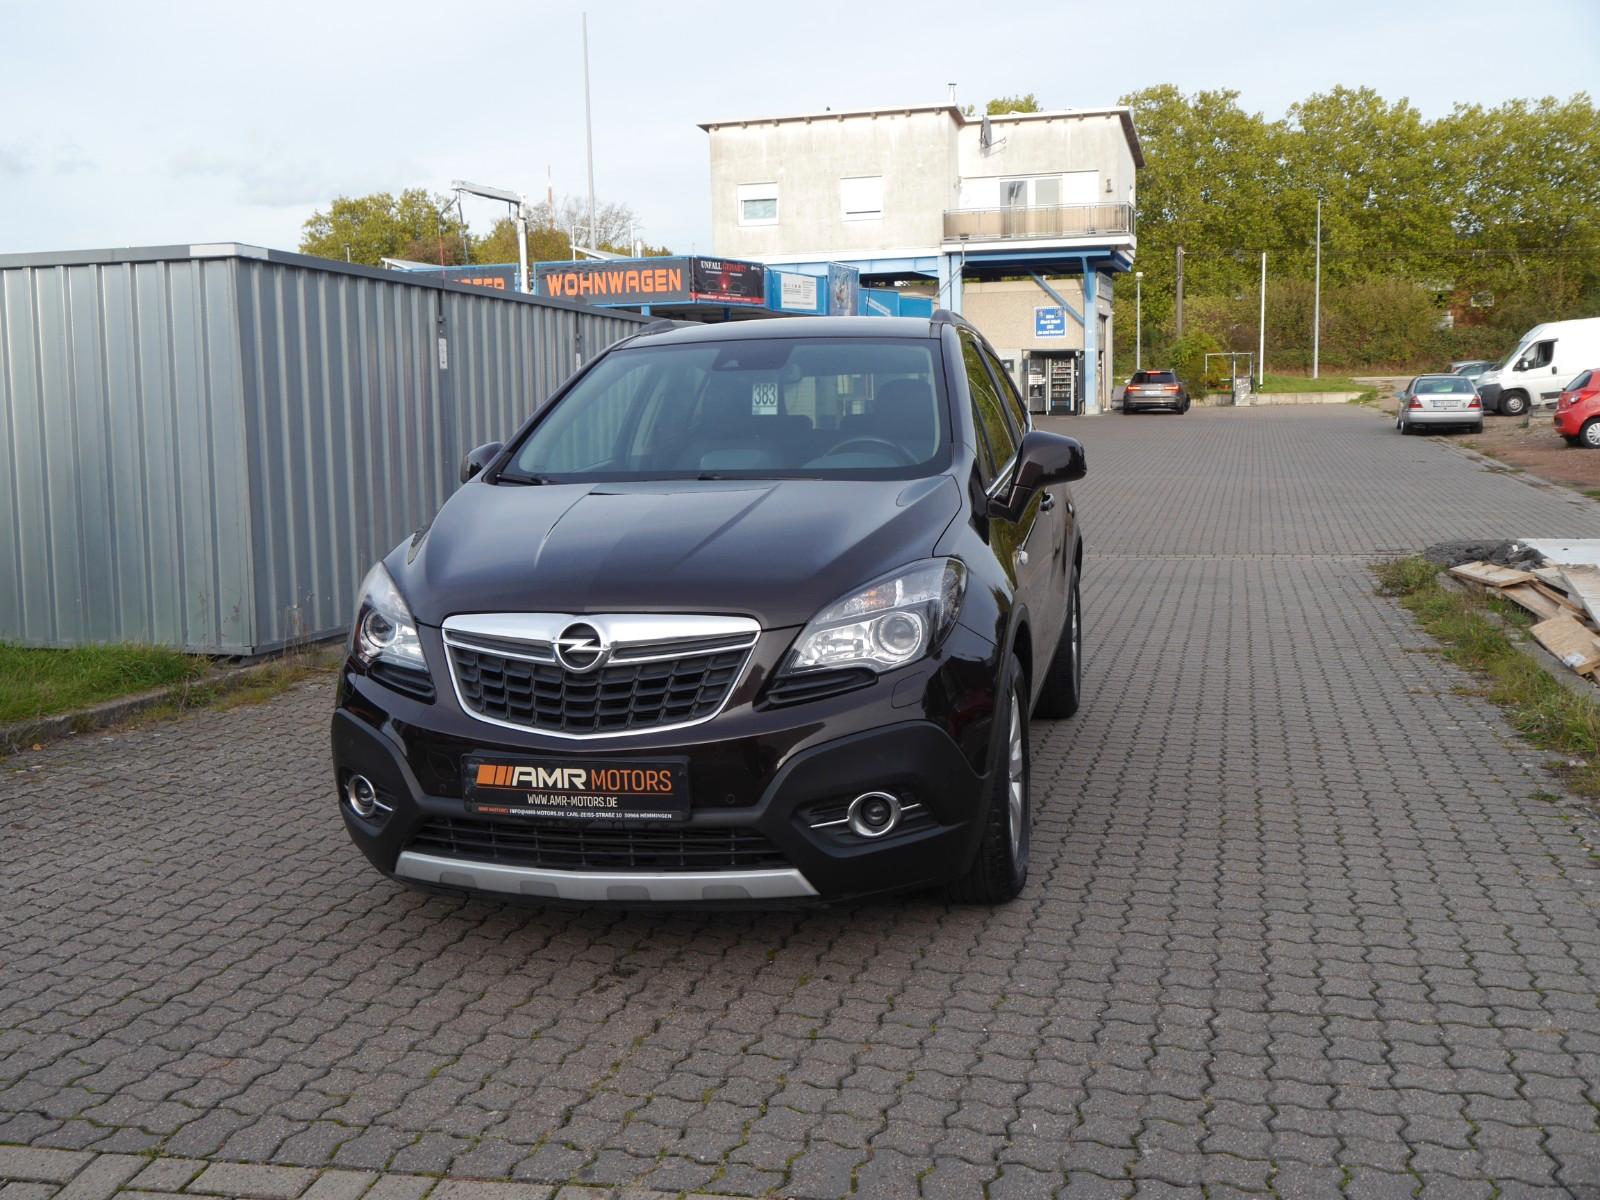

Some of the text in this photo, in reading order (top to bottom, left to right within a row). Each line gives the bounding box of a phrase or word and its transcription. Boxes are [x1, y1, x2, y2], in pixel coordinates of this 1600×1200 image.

[546, 268, 682, 297] WOHNWAGEN
[754, 384, 776, 405] 383
[511, 766, 673, 792] AMR MOTORS
[527, 793, 618, 808] WWW.AMR-MOTORS.DE
